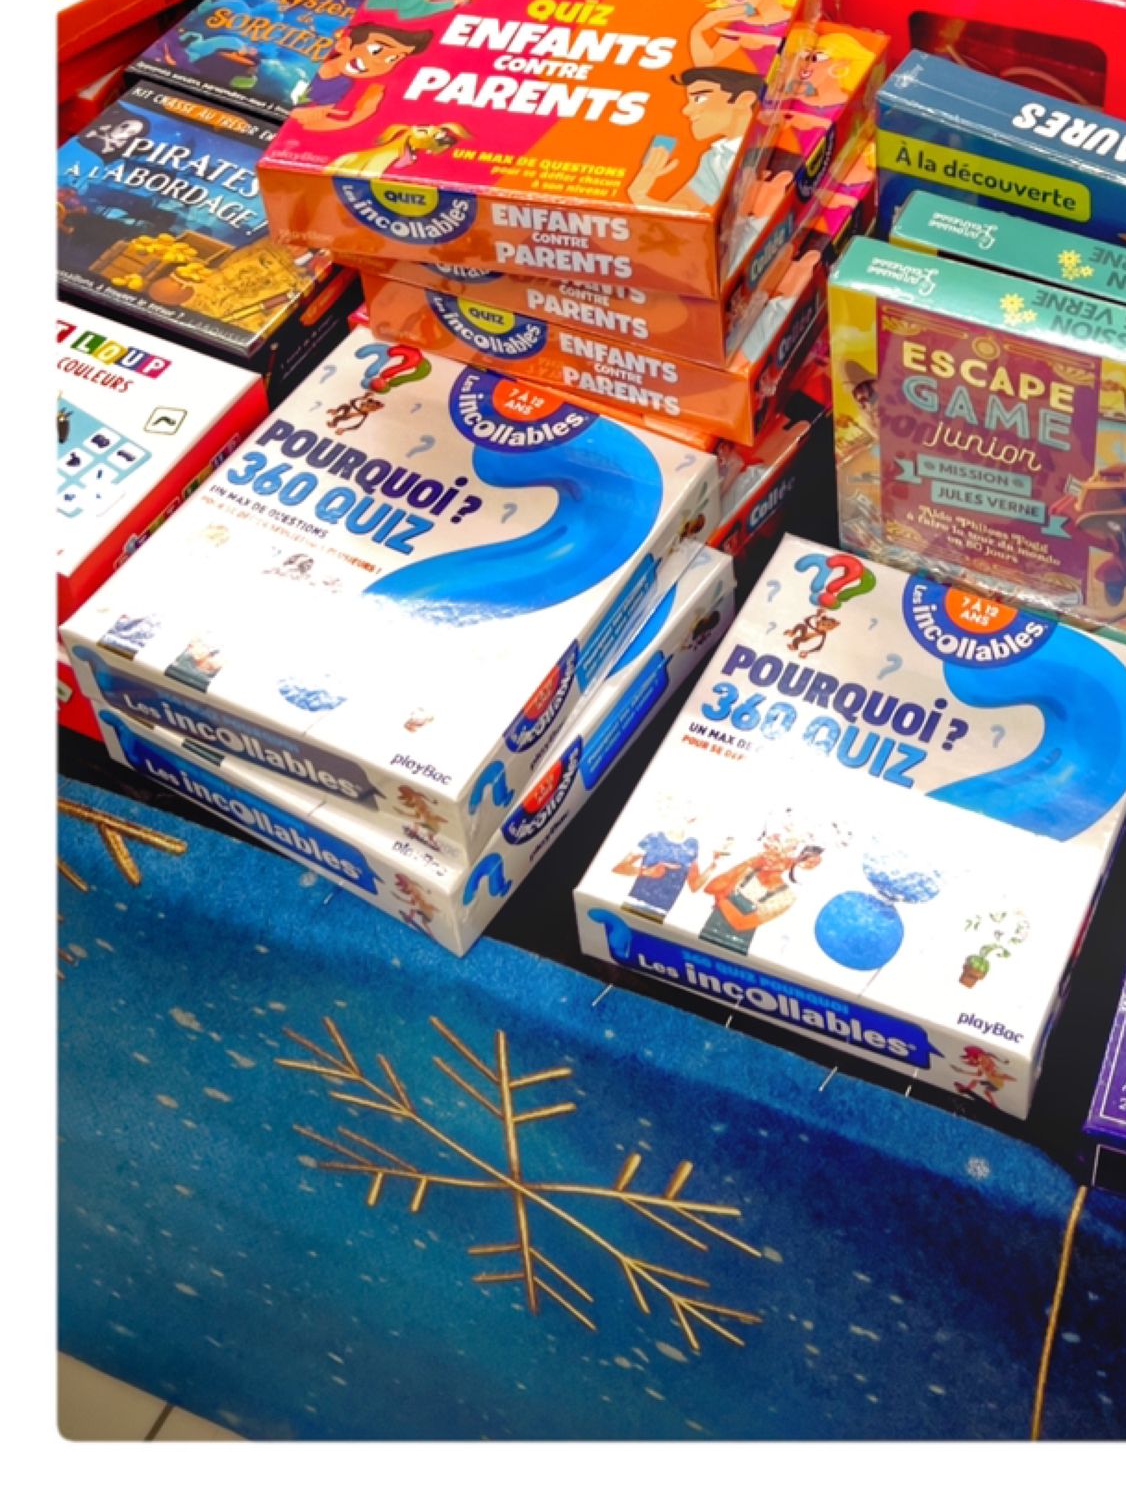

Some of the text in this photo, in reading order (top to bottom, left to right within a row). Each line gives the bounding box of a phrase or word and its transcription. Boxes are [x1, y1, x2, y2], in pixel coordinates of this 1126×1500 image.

[441, 14, 676, 69] ENFANTS
[494, 55, 593, 80] CONTRE
[403, 66, 650, 126] PARENTS
[121, 136, 260, 199] PIRATES
[383, 190, 427, 206] QUIZ
[492, 203, 630, 241] ENFANTS
[495, 241, 633, 279] PARENTS
[57, 356, 134, 393] COULEURS
[902, 341, 1075, 414] ESCAPE
[902, 375, 1072, 451] GAME
[255, 418, 469, 514] POURQUOI
[923, 420, 1042, 472] junior
[938, 462, 1011, 487] MISSION
[227, 450, 319, 507] 360
[314, 486, 436, 555] QUIZ
[937, 487, 1040, 518] JULES VERNE
[960, 610, 989, 627] ANS
[391, 753, 453, 786] playBac
[145, 758, 180, 788] Les
[182, 767, 363, 881] incollables
[638, 953, 911, 1058] Les incollables
[714, 961, 754, 979] QUIZ
[758, 972, 850, 1014] POURQUOI
[957, 1010, 1024, 1044] playBac
